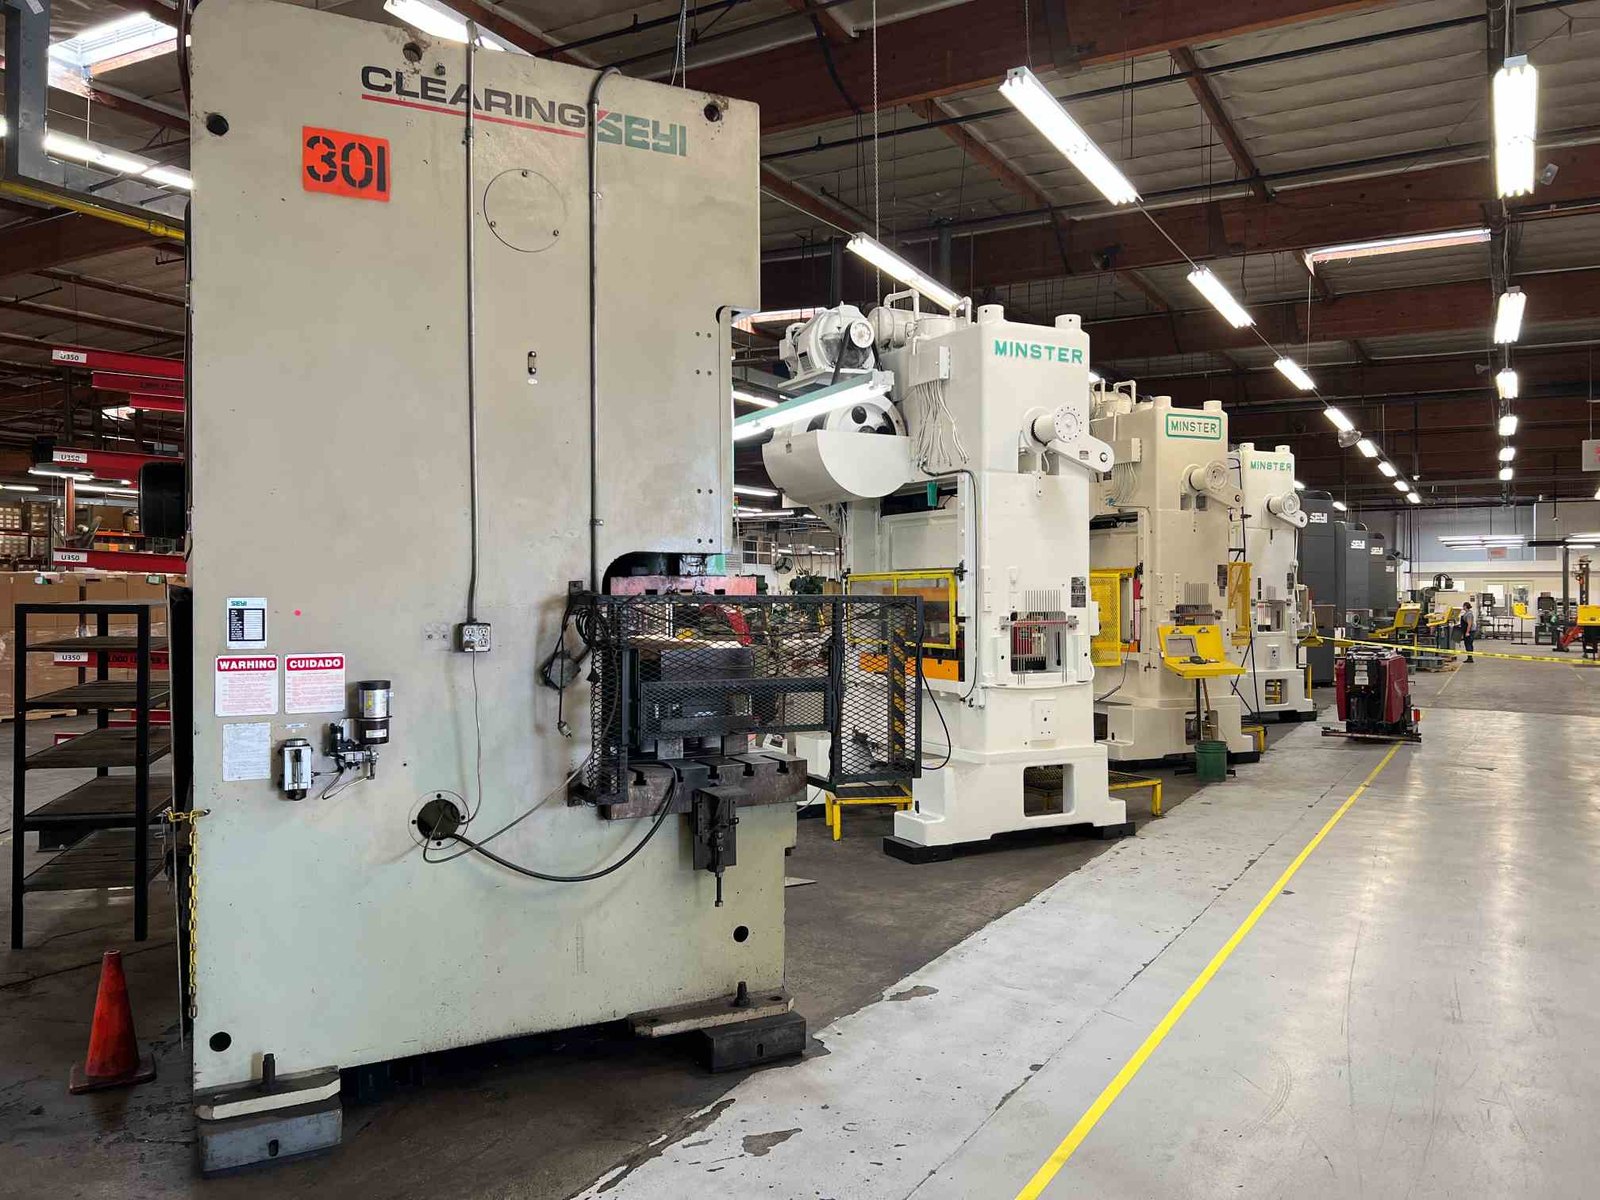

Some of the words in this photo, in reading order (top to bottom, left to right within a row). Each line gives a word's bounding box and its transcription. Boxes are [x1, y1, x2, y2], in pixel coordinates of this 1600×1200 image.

[361, 65, 586, 129] CLEARING
[595, 111, 687, 157] SEYI
[306, 135, 386, 192] 301
[994, 339, 1083, 364] MINSTER
[1170, 420, 1217, 434] MINSTER
[1250, 460, 1292, 473] MINSTER
[60, 553, 80, 561] U350
[61, 653, 82, 661] U350
[289, 658, 341, 669] CUIDADO
